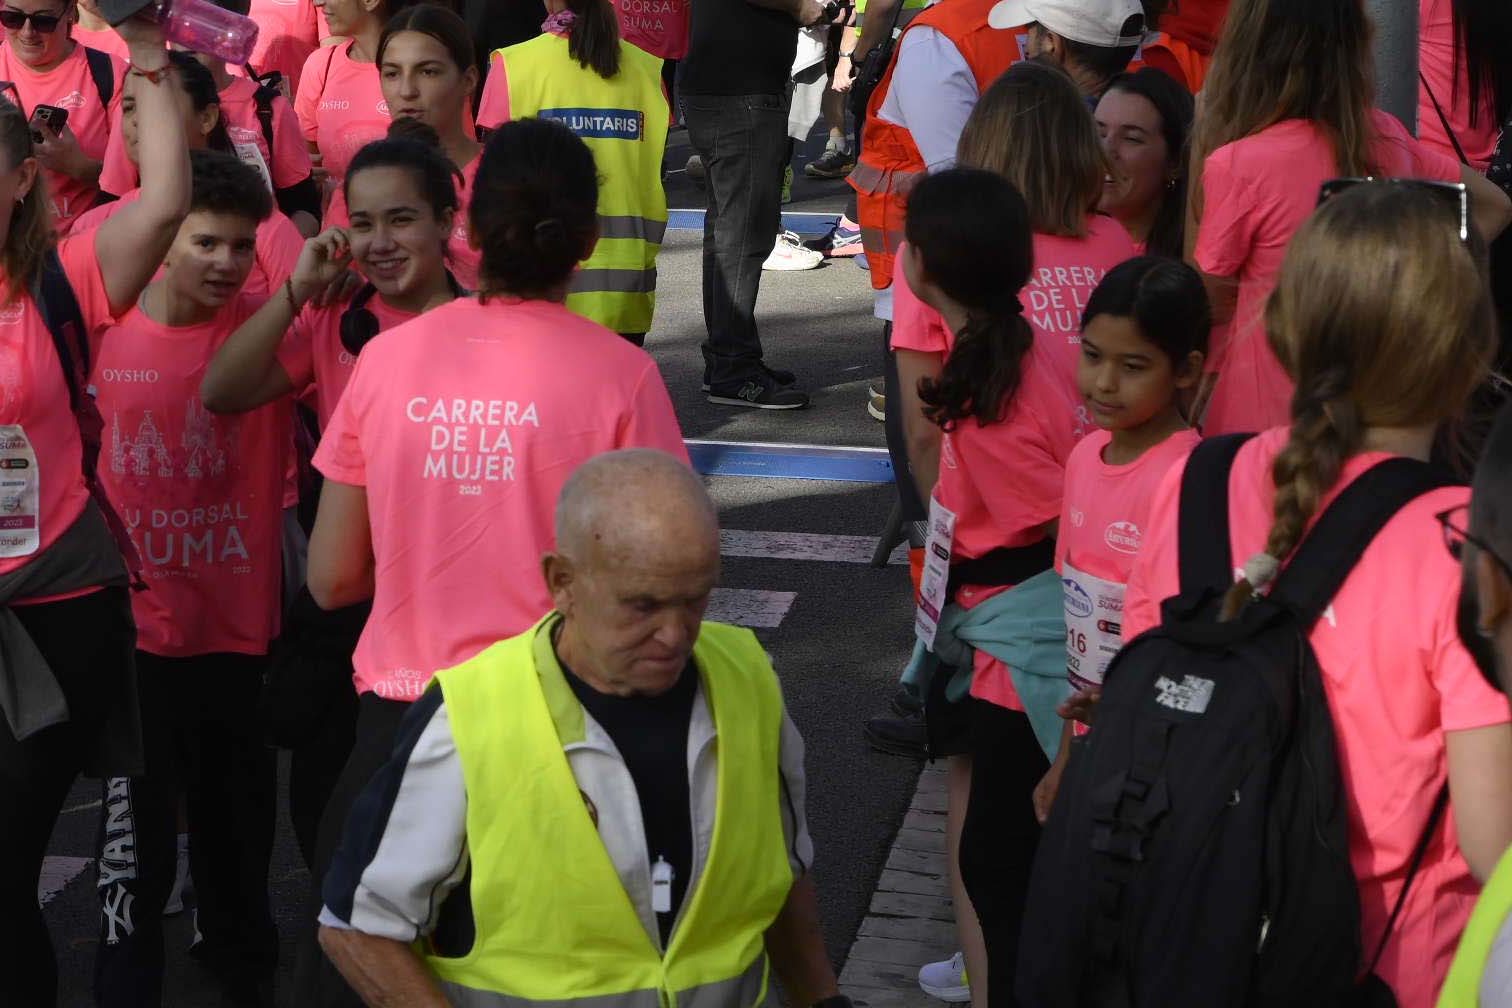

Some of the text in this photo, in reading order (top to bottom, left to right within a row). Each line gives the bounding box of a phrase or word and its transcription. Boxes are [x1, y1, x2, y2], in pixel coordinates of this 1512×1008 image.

[621, 0, 678, 12] DORSAL
[623, 15, 664, 30] SUMA
[550, 116, 637, 132] LUNTARIS
[1030, 288, 1065, 311] DE
[103, 369, 159, 383] OYSHO
[406, 397, 540, 428] CARRERA
[430, 425, 513, 454] DE LA
[423, 455, 516, 482] MUJER
[151, 502, 249, 528] DORSAL
[145, 526, 249, 568] UMA
[1065, 628, 1087, 654] 16
[97, 777, 139, 889] YANK
